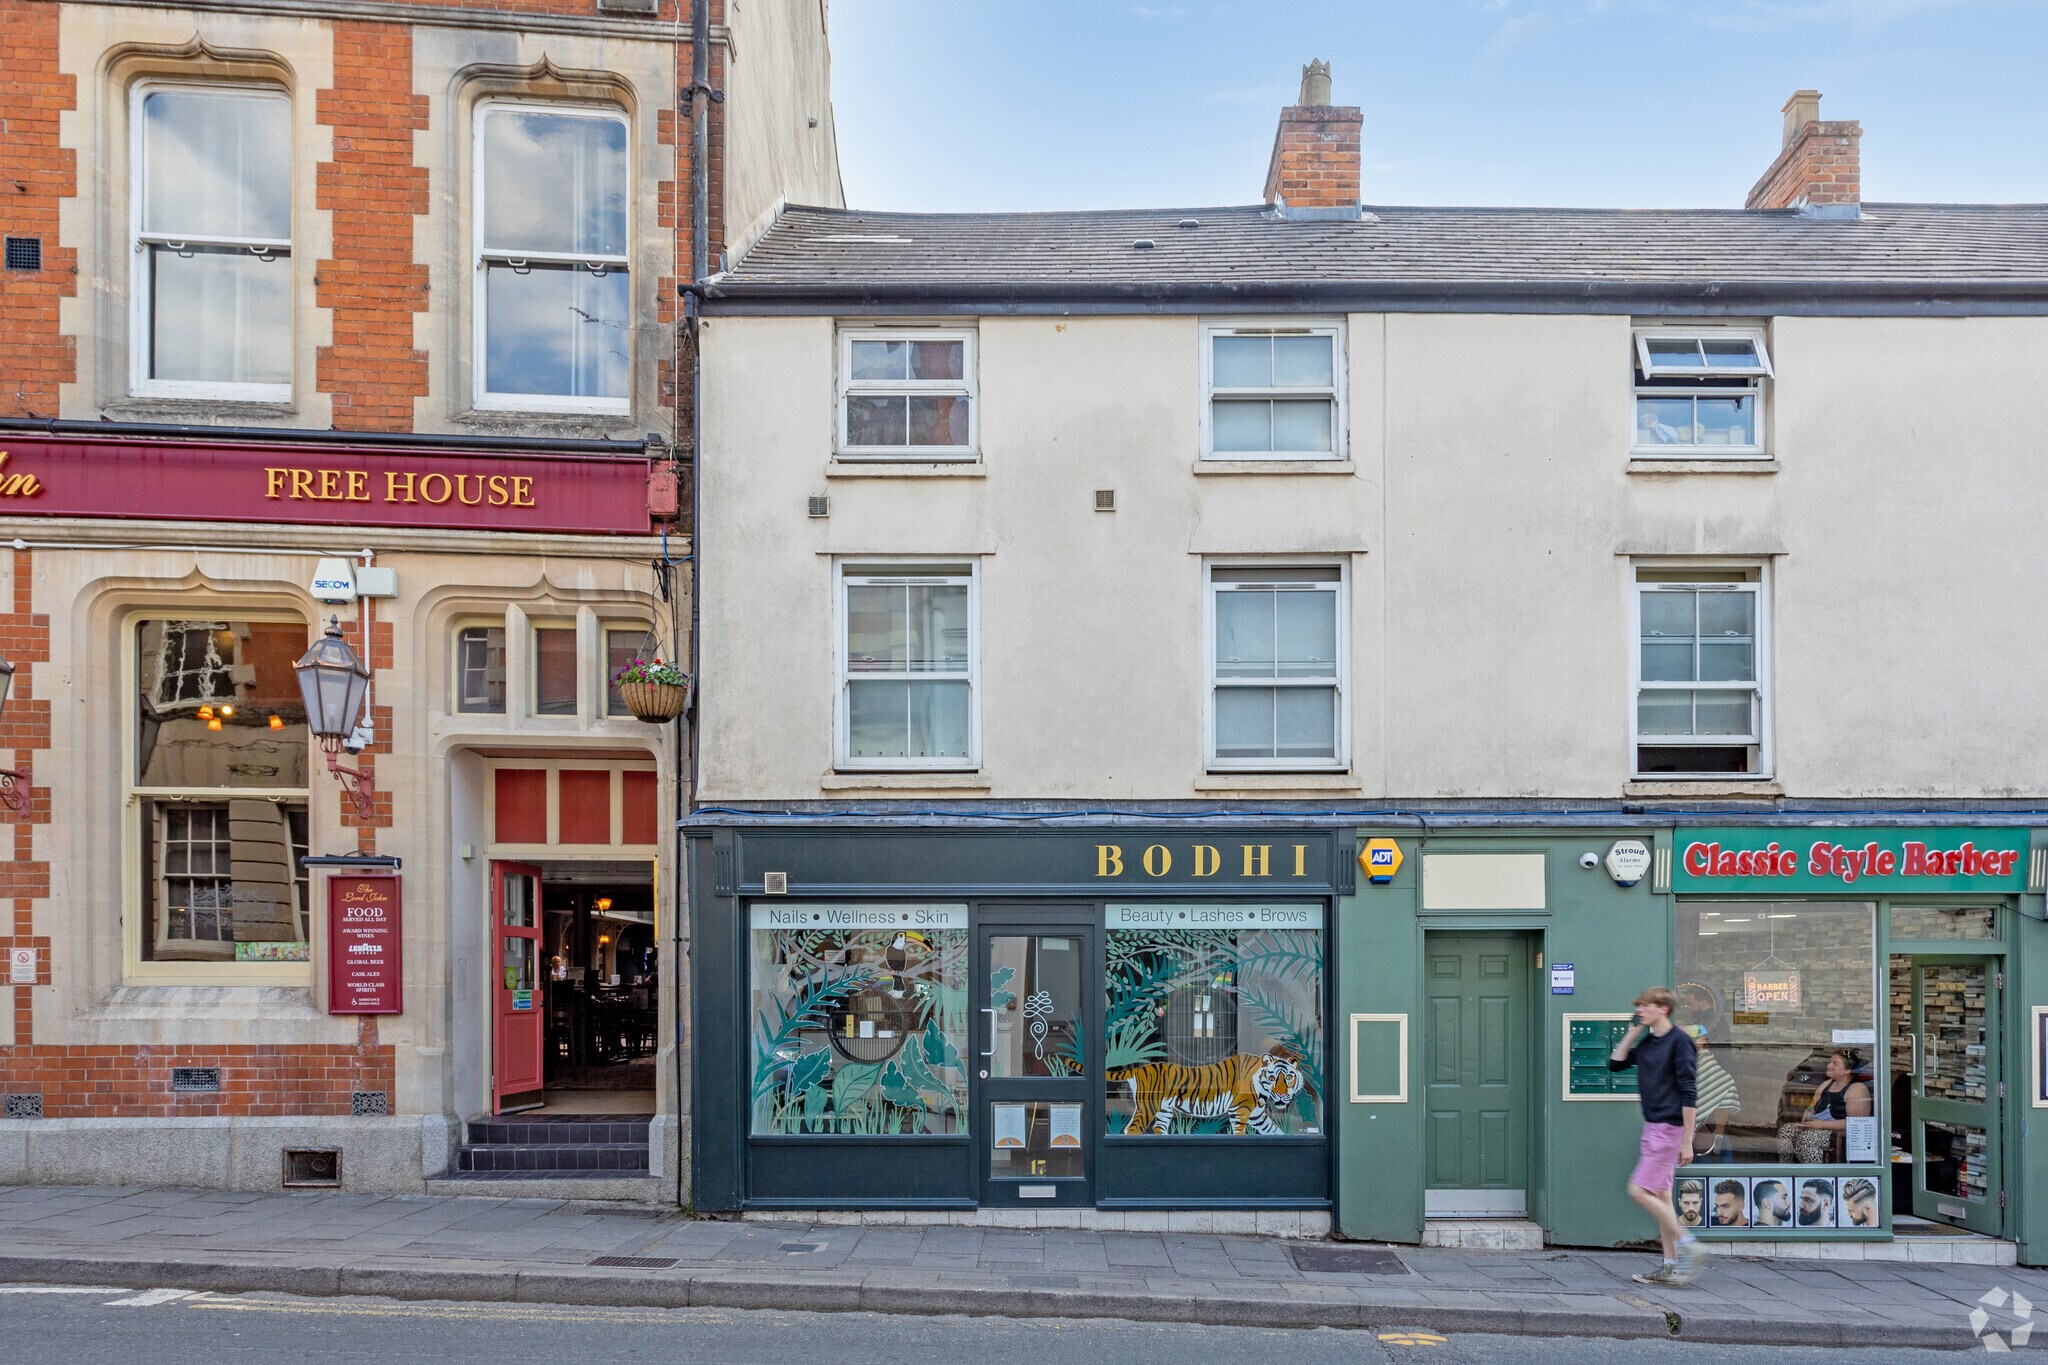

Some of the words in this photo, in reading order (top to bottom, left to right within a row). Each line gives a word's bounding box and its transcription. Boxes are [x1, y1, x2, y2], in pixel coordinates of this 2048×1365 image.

[0, 451, 41, 496] n
[264, 467, 371, 501] FREE
[383, 471, 536, 506] HOUSE
[315, 580, 350, 589] SECOM
[1372, 851, 1393, 863] ADT
[1615, 848, 1645, 856] Stroud
[1094, 844, 1309, 878] BODHI
[1683, 841, 1798, 877] Classic
[1808, 841, 1897, 884] Style
[1900, 841, 2019, 877] Barber
[356, 884, 374, 893] The
[341, 892, 366, 902] Lord
[366, 892, 388, 903] John
[347, 907, 383, 917] FOOD
[769, 908, 808, 925] Nails
[827, 908, 896, 925] Wellness
[915, 908, 949, 925] Skin
[1120, 907, 1173, 926] Beauty
[1190, 907, 1245, 923] Lashes
[1261, 907, 1308, 923] Brows
[1756, 982, 1789, 991] BARBER
[1757, 991, 1788, 1001] OPEN
[1029, 1159, 1047, 1175] 17
